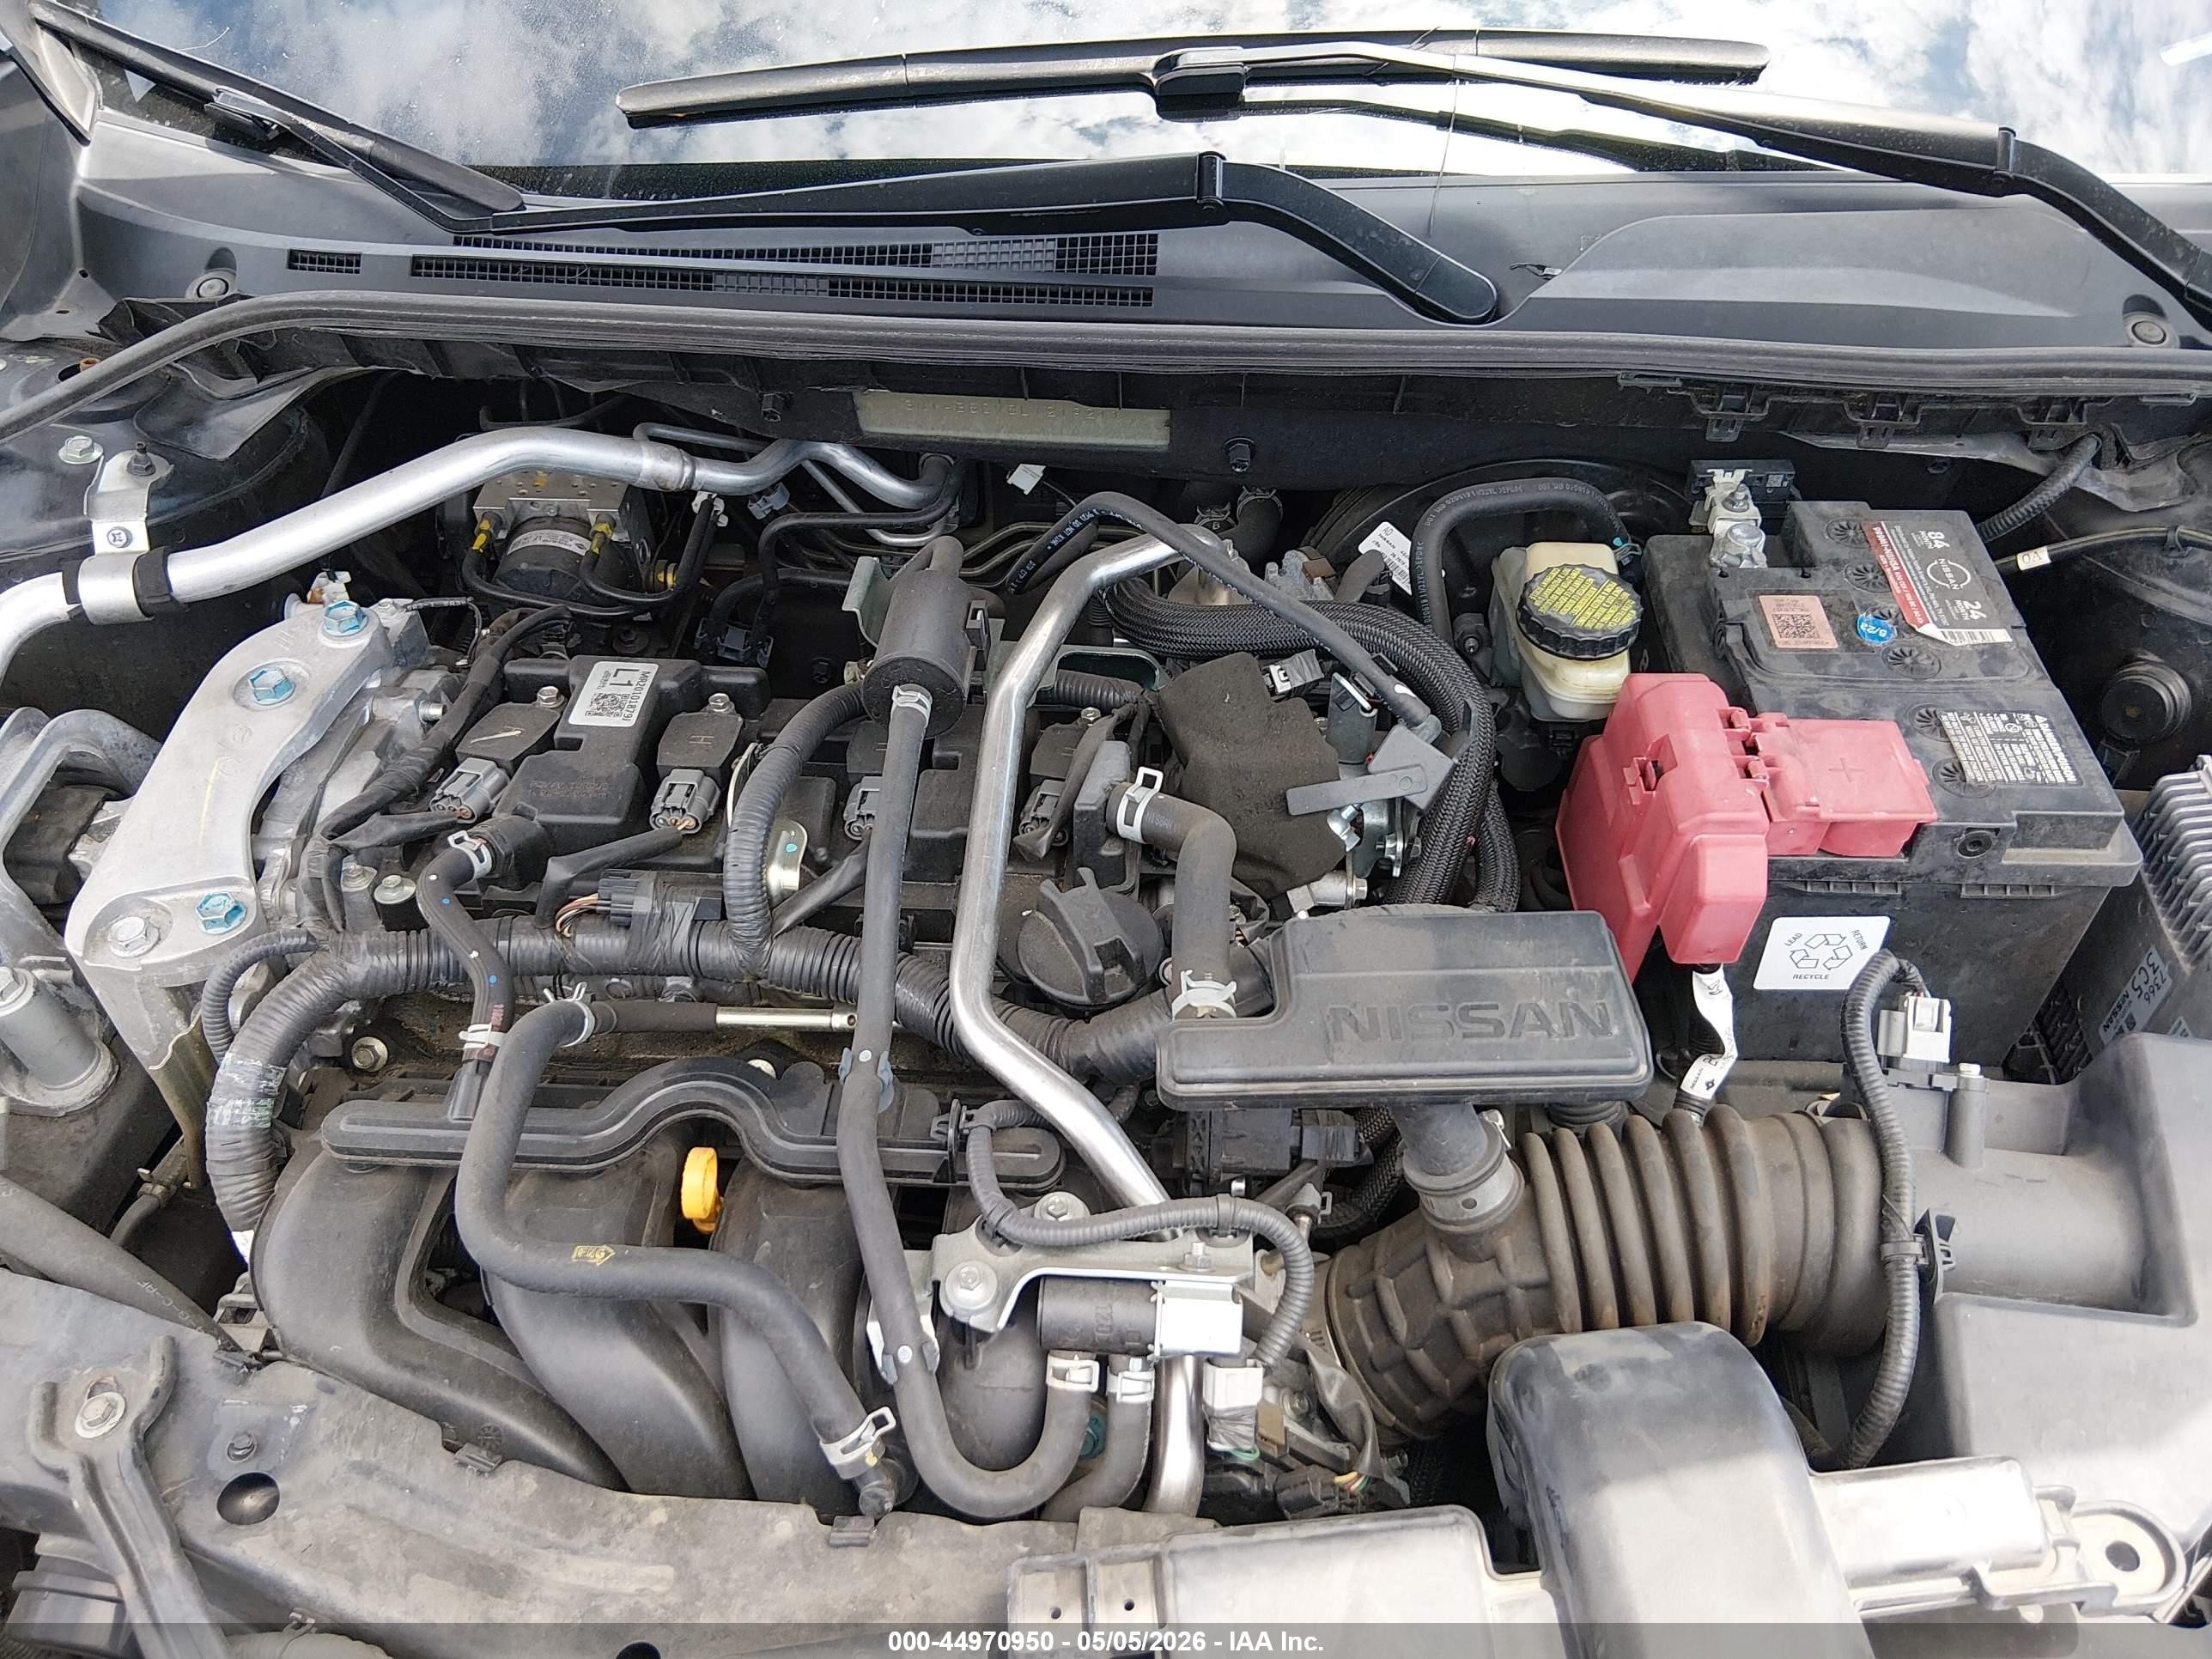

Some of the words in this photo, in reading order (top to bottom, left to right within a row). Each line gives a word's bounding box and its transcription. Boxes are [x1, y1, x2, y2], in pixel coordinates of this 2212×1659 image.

[1926, 530, 1950, 548] 84
[1936, 558, 1960, 589] NISSAN
[1961, 599, 1987, 619] 24
[610, 668, 640, 686] L1
[1784, 933, 1803, 946] LEAD
[1851, 928, 1869, 951] RETURN
[2131, 951, 2160, 999] 3C5
[2144, 970, 2166, 1005] 7366
[1328, 1002, 1615, 1042] NISSAN
[2102, 990, 2129, 1032] NISSAN
